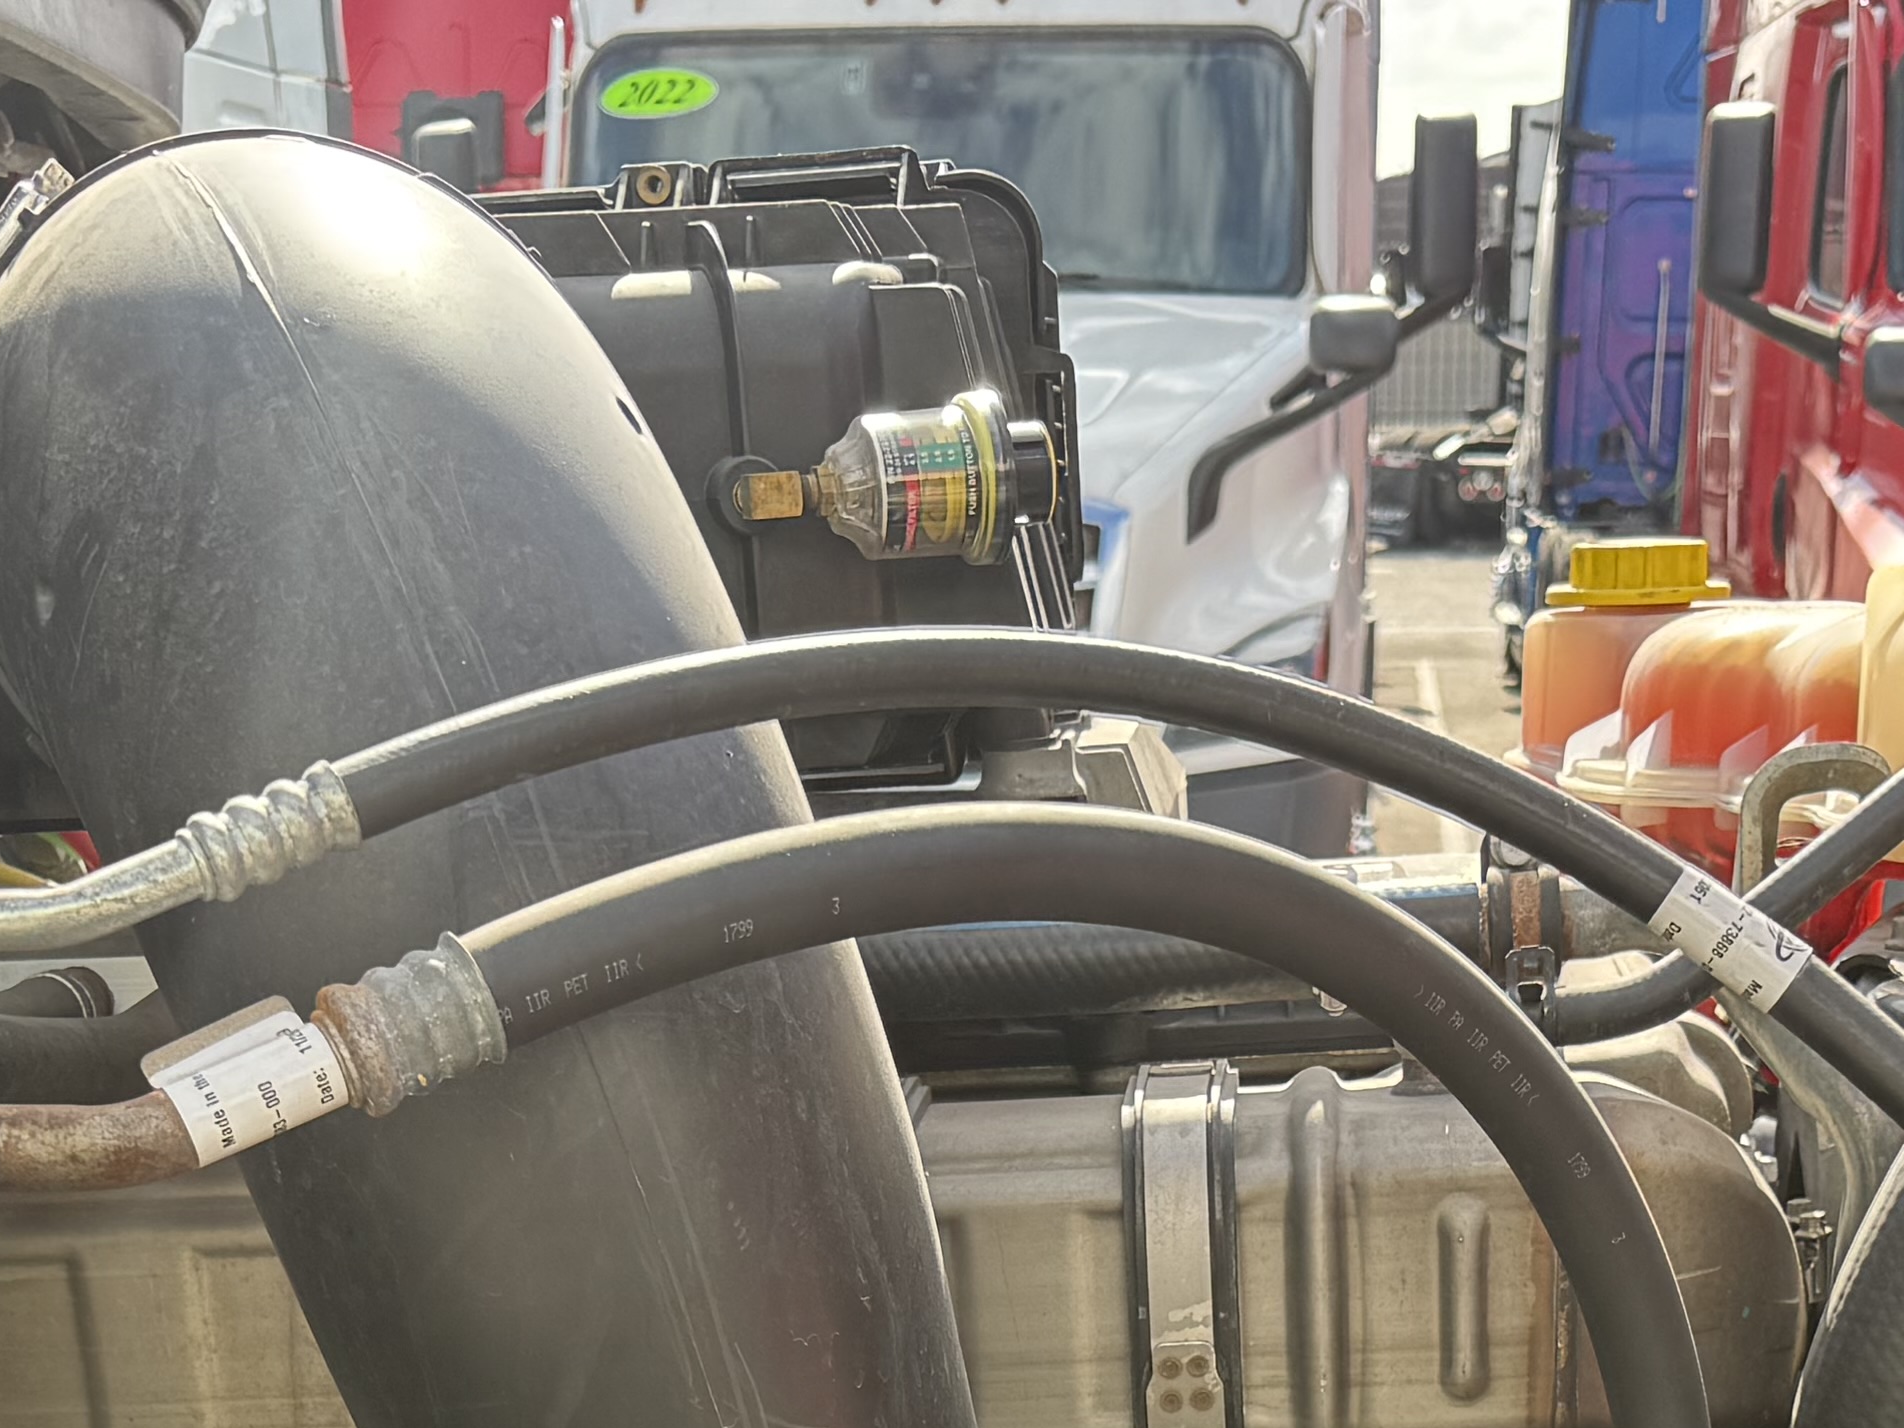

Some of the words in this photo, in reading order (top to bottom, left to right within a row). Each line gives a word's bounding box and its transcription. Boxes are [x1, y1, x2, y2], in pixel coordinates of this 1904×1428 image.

[619, 74, 701, 109] 2022
[962, 444, 979, 485] BUTTON
[967, 487, 978, 515] PUSH
[723, 919, 754, 943] 1799
[525, 989, 551, 1014] IIR
[564, 974, 589, 999] PET
[1488, 1050, 1510, 1072] PET
[204, 1091, 219, 1106] in
[313, 1067, 334, 1103] Date:
[212, 1109, 235, 1147] Made
